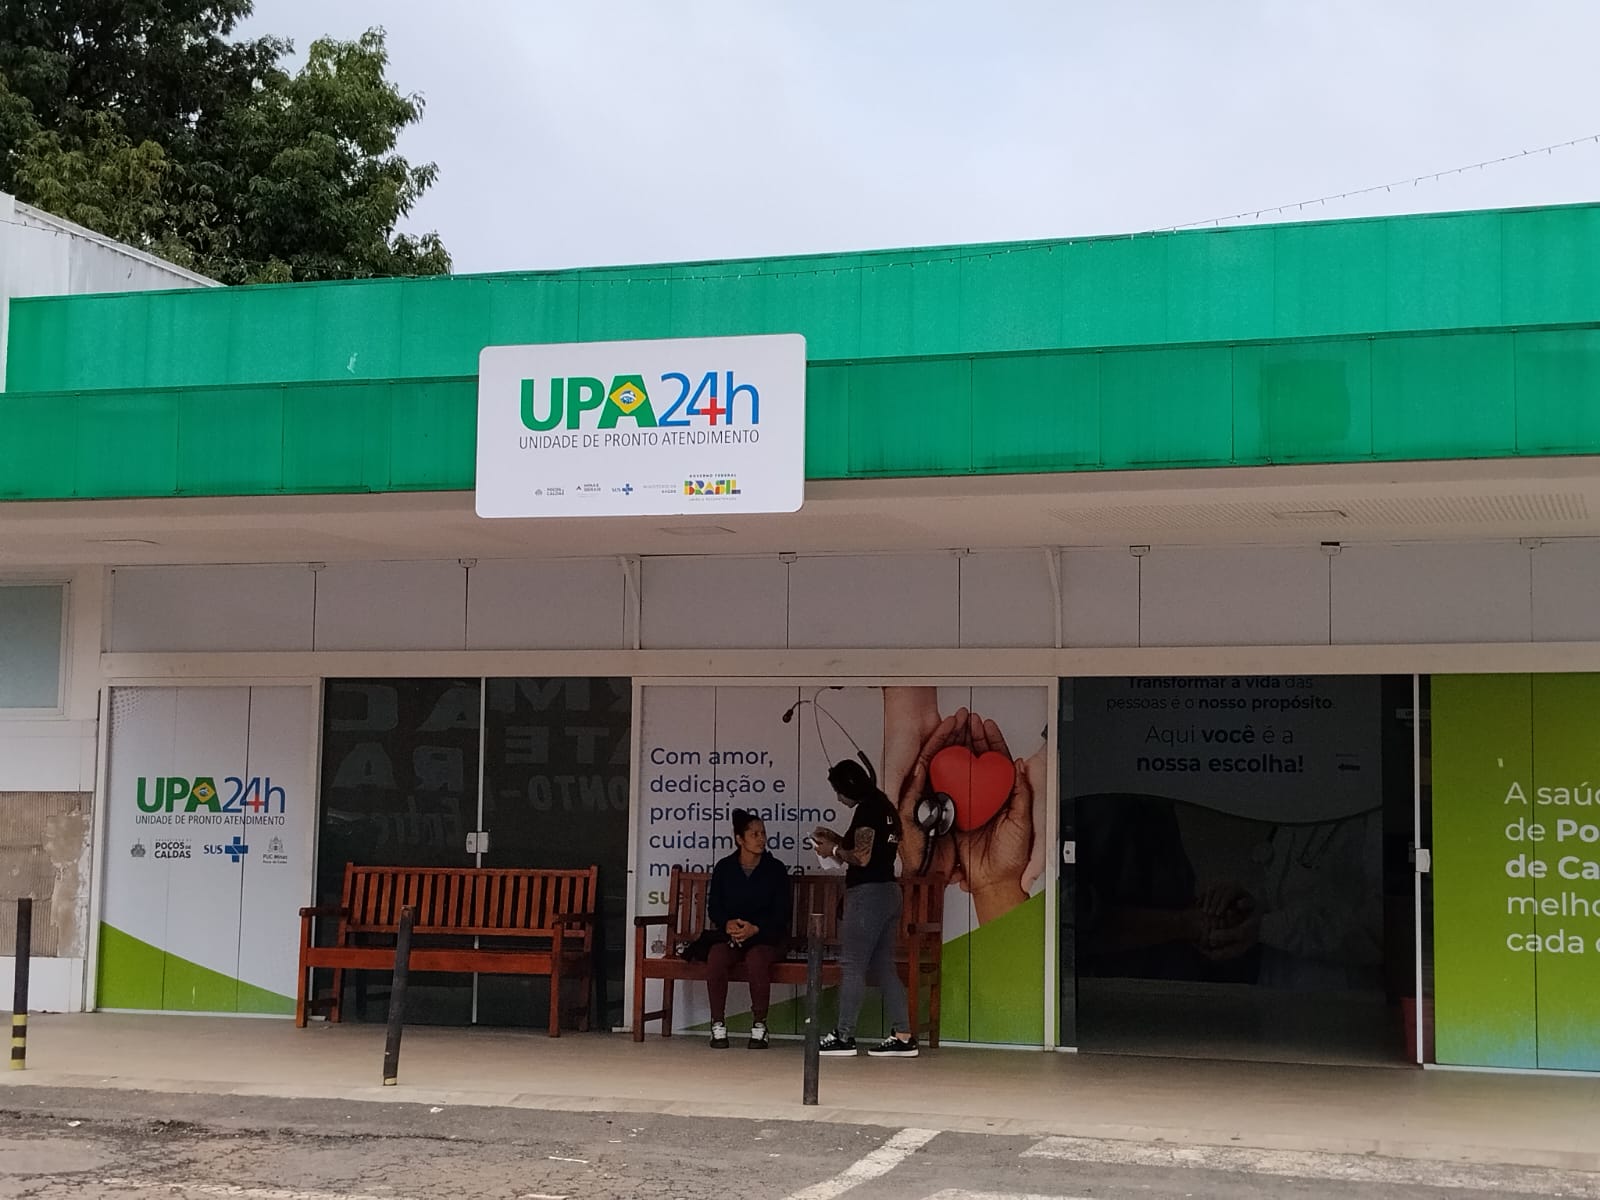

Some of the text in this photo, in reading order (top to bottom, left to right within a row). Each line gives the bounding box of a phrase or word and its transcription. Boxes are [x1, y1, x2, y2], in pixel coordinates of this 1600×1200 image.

[519, 429, 759, 450] UNIDADE DE PRONTO ATENDIMENTO
[683, 479, 741, 495] BRASIL
[1128, 677, 1226, 689] Transformar
[1231, 679, 1241, 689] a
[1245, 676, 1280, 689] vida
[1106, 696, 1168, 712] pessoas
[1184, 696, 1194, 709] o
[1198, 696, 1247, 710] nosso
[1145, 725, 1293, 747] Aqui você é a
[650, 747, 773, 767] Com amor,
[1136, 753, 1303, 774] nossa escolha!
[650, 774, 785, 797] dedicação e
[1504, 782, 1528, 804] A
[136, 815, 285, 826] UNIDADE DE PRONTO ATENDIMENTO
[650, 802, 836, 824] profissinalismo
[1505, 817, 1546, 841] de
[155, 841, 185, 851] POÇOS
[203, 844, 223, 855] SUS
[767, 832, 795, 850] de
[154, 850, 191, 859] CALDAS
[1505, 853, 1547, 878] de
[1506, 928, 1584, 954] cada
